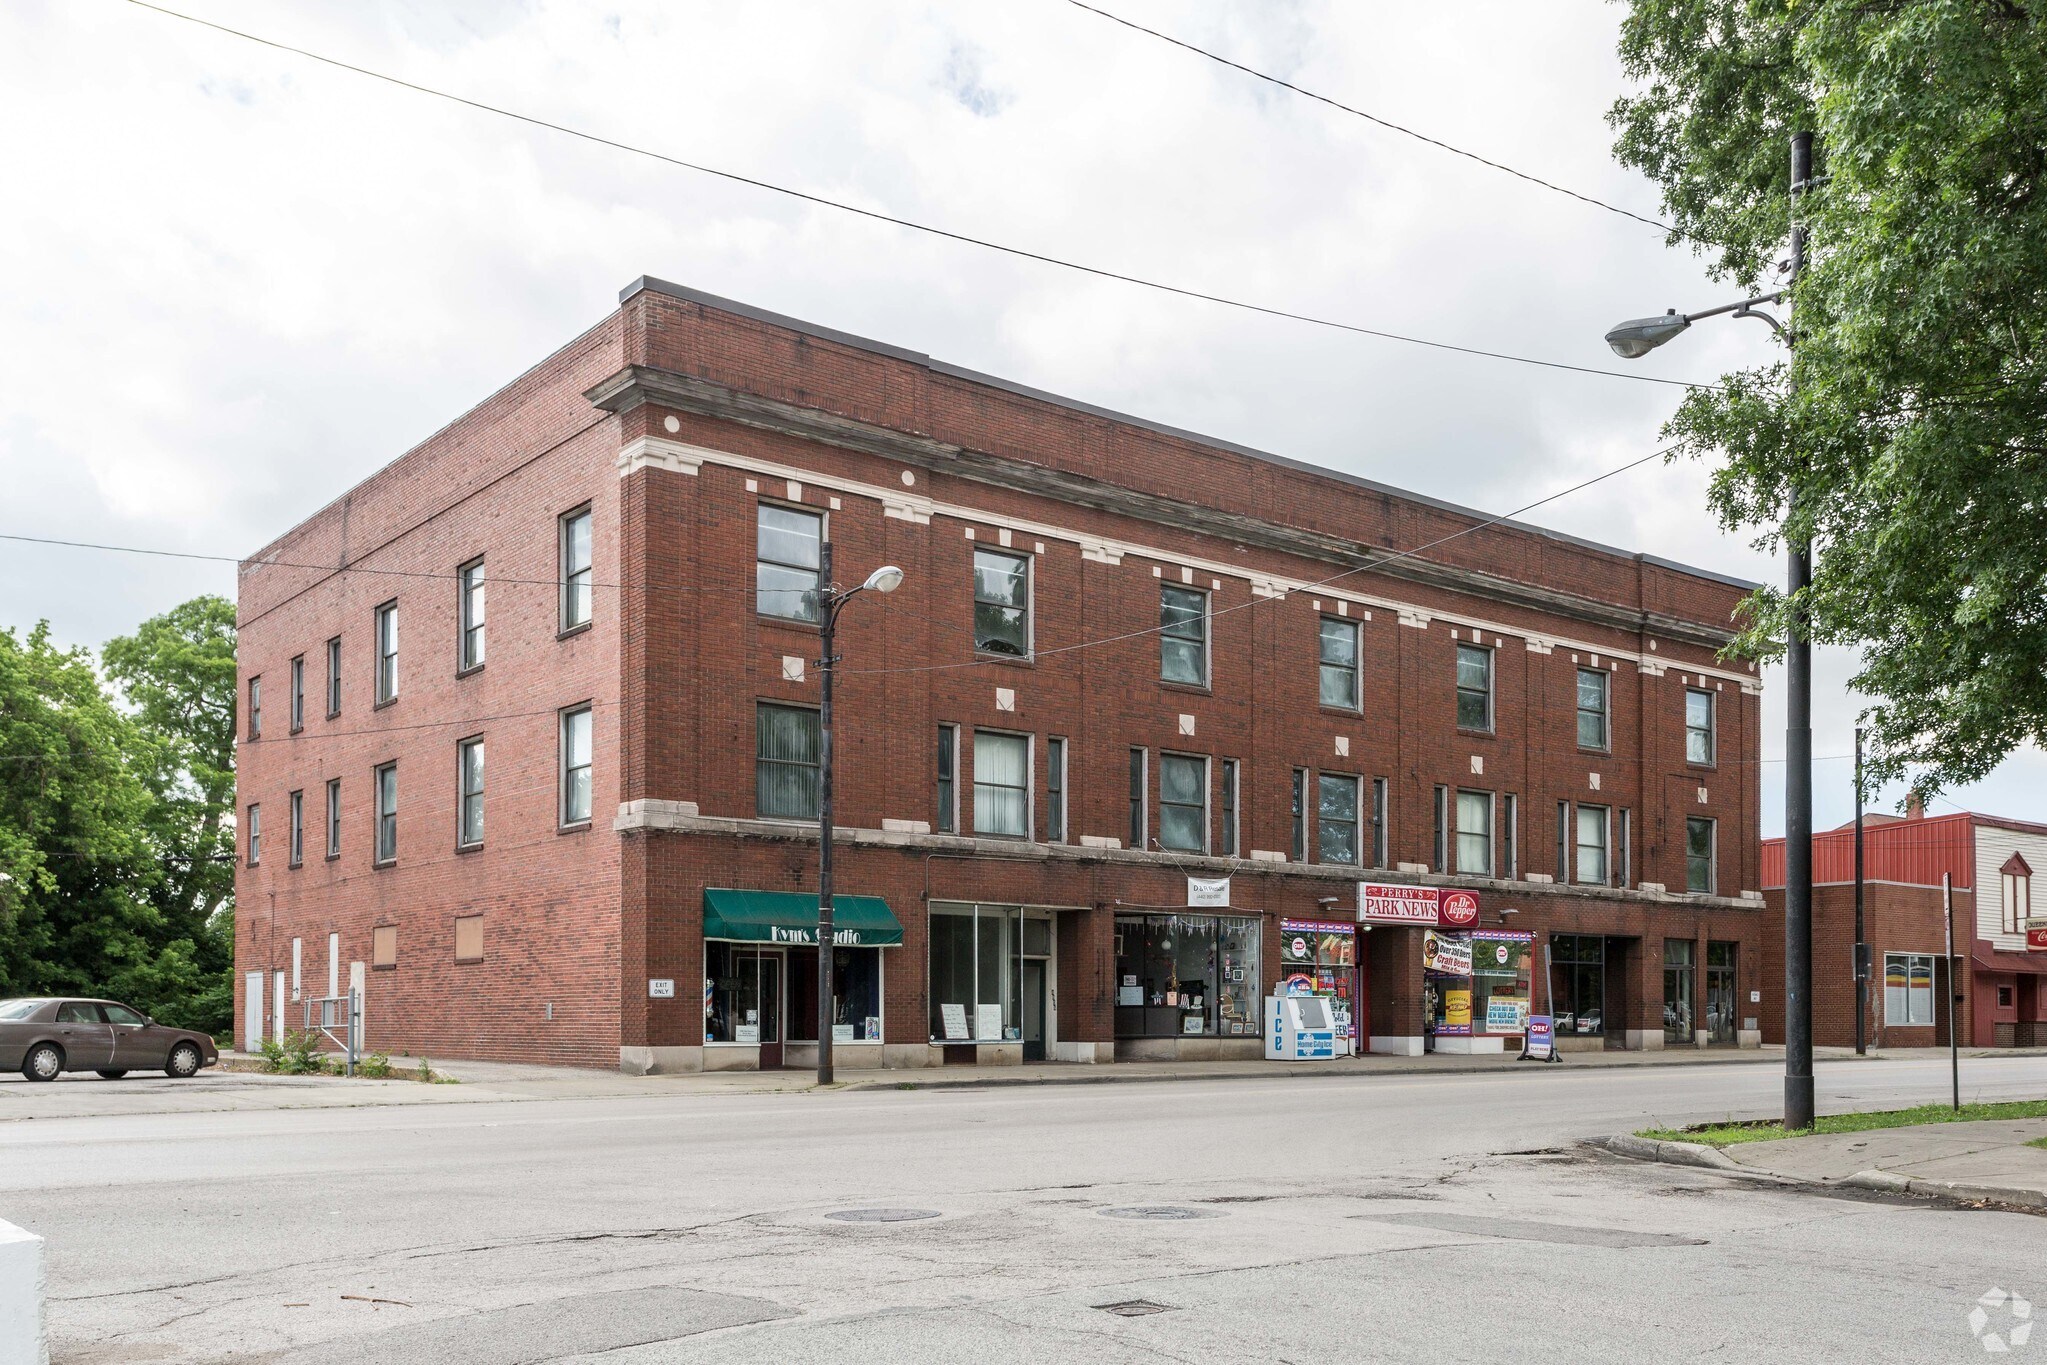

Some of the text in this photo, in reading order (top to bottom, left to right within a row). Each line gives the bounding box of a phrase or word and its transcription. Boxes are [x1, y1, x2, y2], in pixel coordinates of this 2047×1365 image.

[1381, 888, 1423, 899] PERRY'S
[1365, 899, 1437, 918] PARK NEWS
[1457, 897, 1470, 908] Dr
[1448, 901, 1475, 919] Pepper
[814, 927, 861, 945] Sudio
[1439, 945, 1452, 954] Over
[1437, 954, 1470, 970] Craft Beers
[1531, 1024, 1548, 1032] OH!
